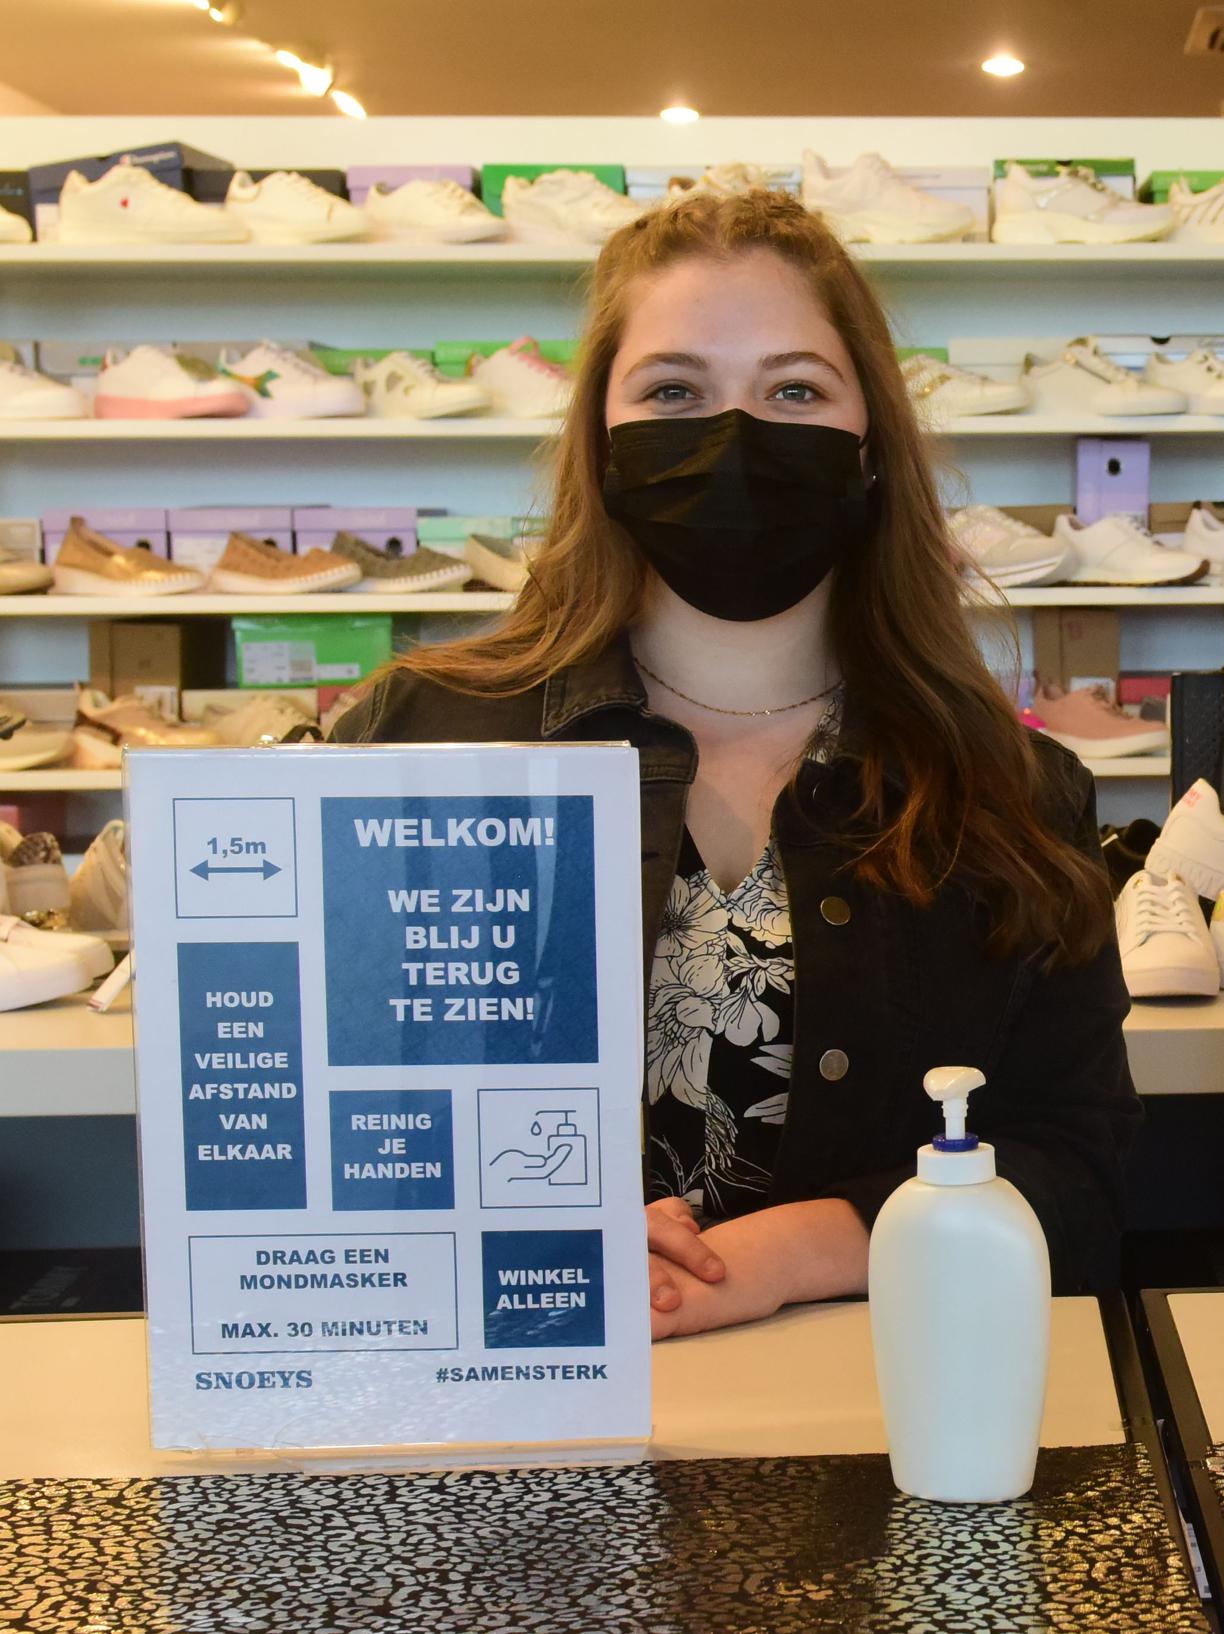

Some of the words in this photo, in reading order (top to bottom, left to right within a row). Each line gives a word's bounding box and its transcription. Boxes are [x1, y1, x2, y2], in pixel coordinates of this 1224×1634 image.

[354, 818, 554, 847] WELKOM!
[205, 837, 268, 860] 1,5m
[388, 890, 440, 912] WE
[451, 889, 529, 912] ZIJN
[406, 926, 479, 949] BLIJ
[493, 926, 515, 948] U
[402, 962, 519, 985] TERUG
[207, 992, 273, 1007] HOUD
[389, 999, 432, 1021] TE
[444, 998, 533, 1021] ZIEN!
[218, 1022, 263, 1038] EEN
[195, 1053, 288, 1069] VEILIGE
[189, 1083, 296, 1099] AFSTAND
[219, 1114, 267, 1129] VAN
[352, 1114, 431, 1130] REINIG
[198, 1144, 292, 1160] ELKAAR
[378, 1139, 406, 1154] JE
[344, 1163, 441, 1179] HANDEN
[256, 1250, 335, 1265] DRAAG
[345, 1249, 389, 1264] EEN
[240, 1273, 407, 1289] MONDMASKER
[498, 1269, 589, 1285] WINKEL
[496, 1292, 586, 1310] ALLEEN
[222, 1323, 278, 1338] MAX.
[287, 1322, 313, 1337] 30
[322, 1320, 428, 1336] MINUTEN
[196, 1370, 312, 1390] SNOEYS
[436, 1365, 607, 1382] #SAMENSTERK
